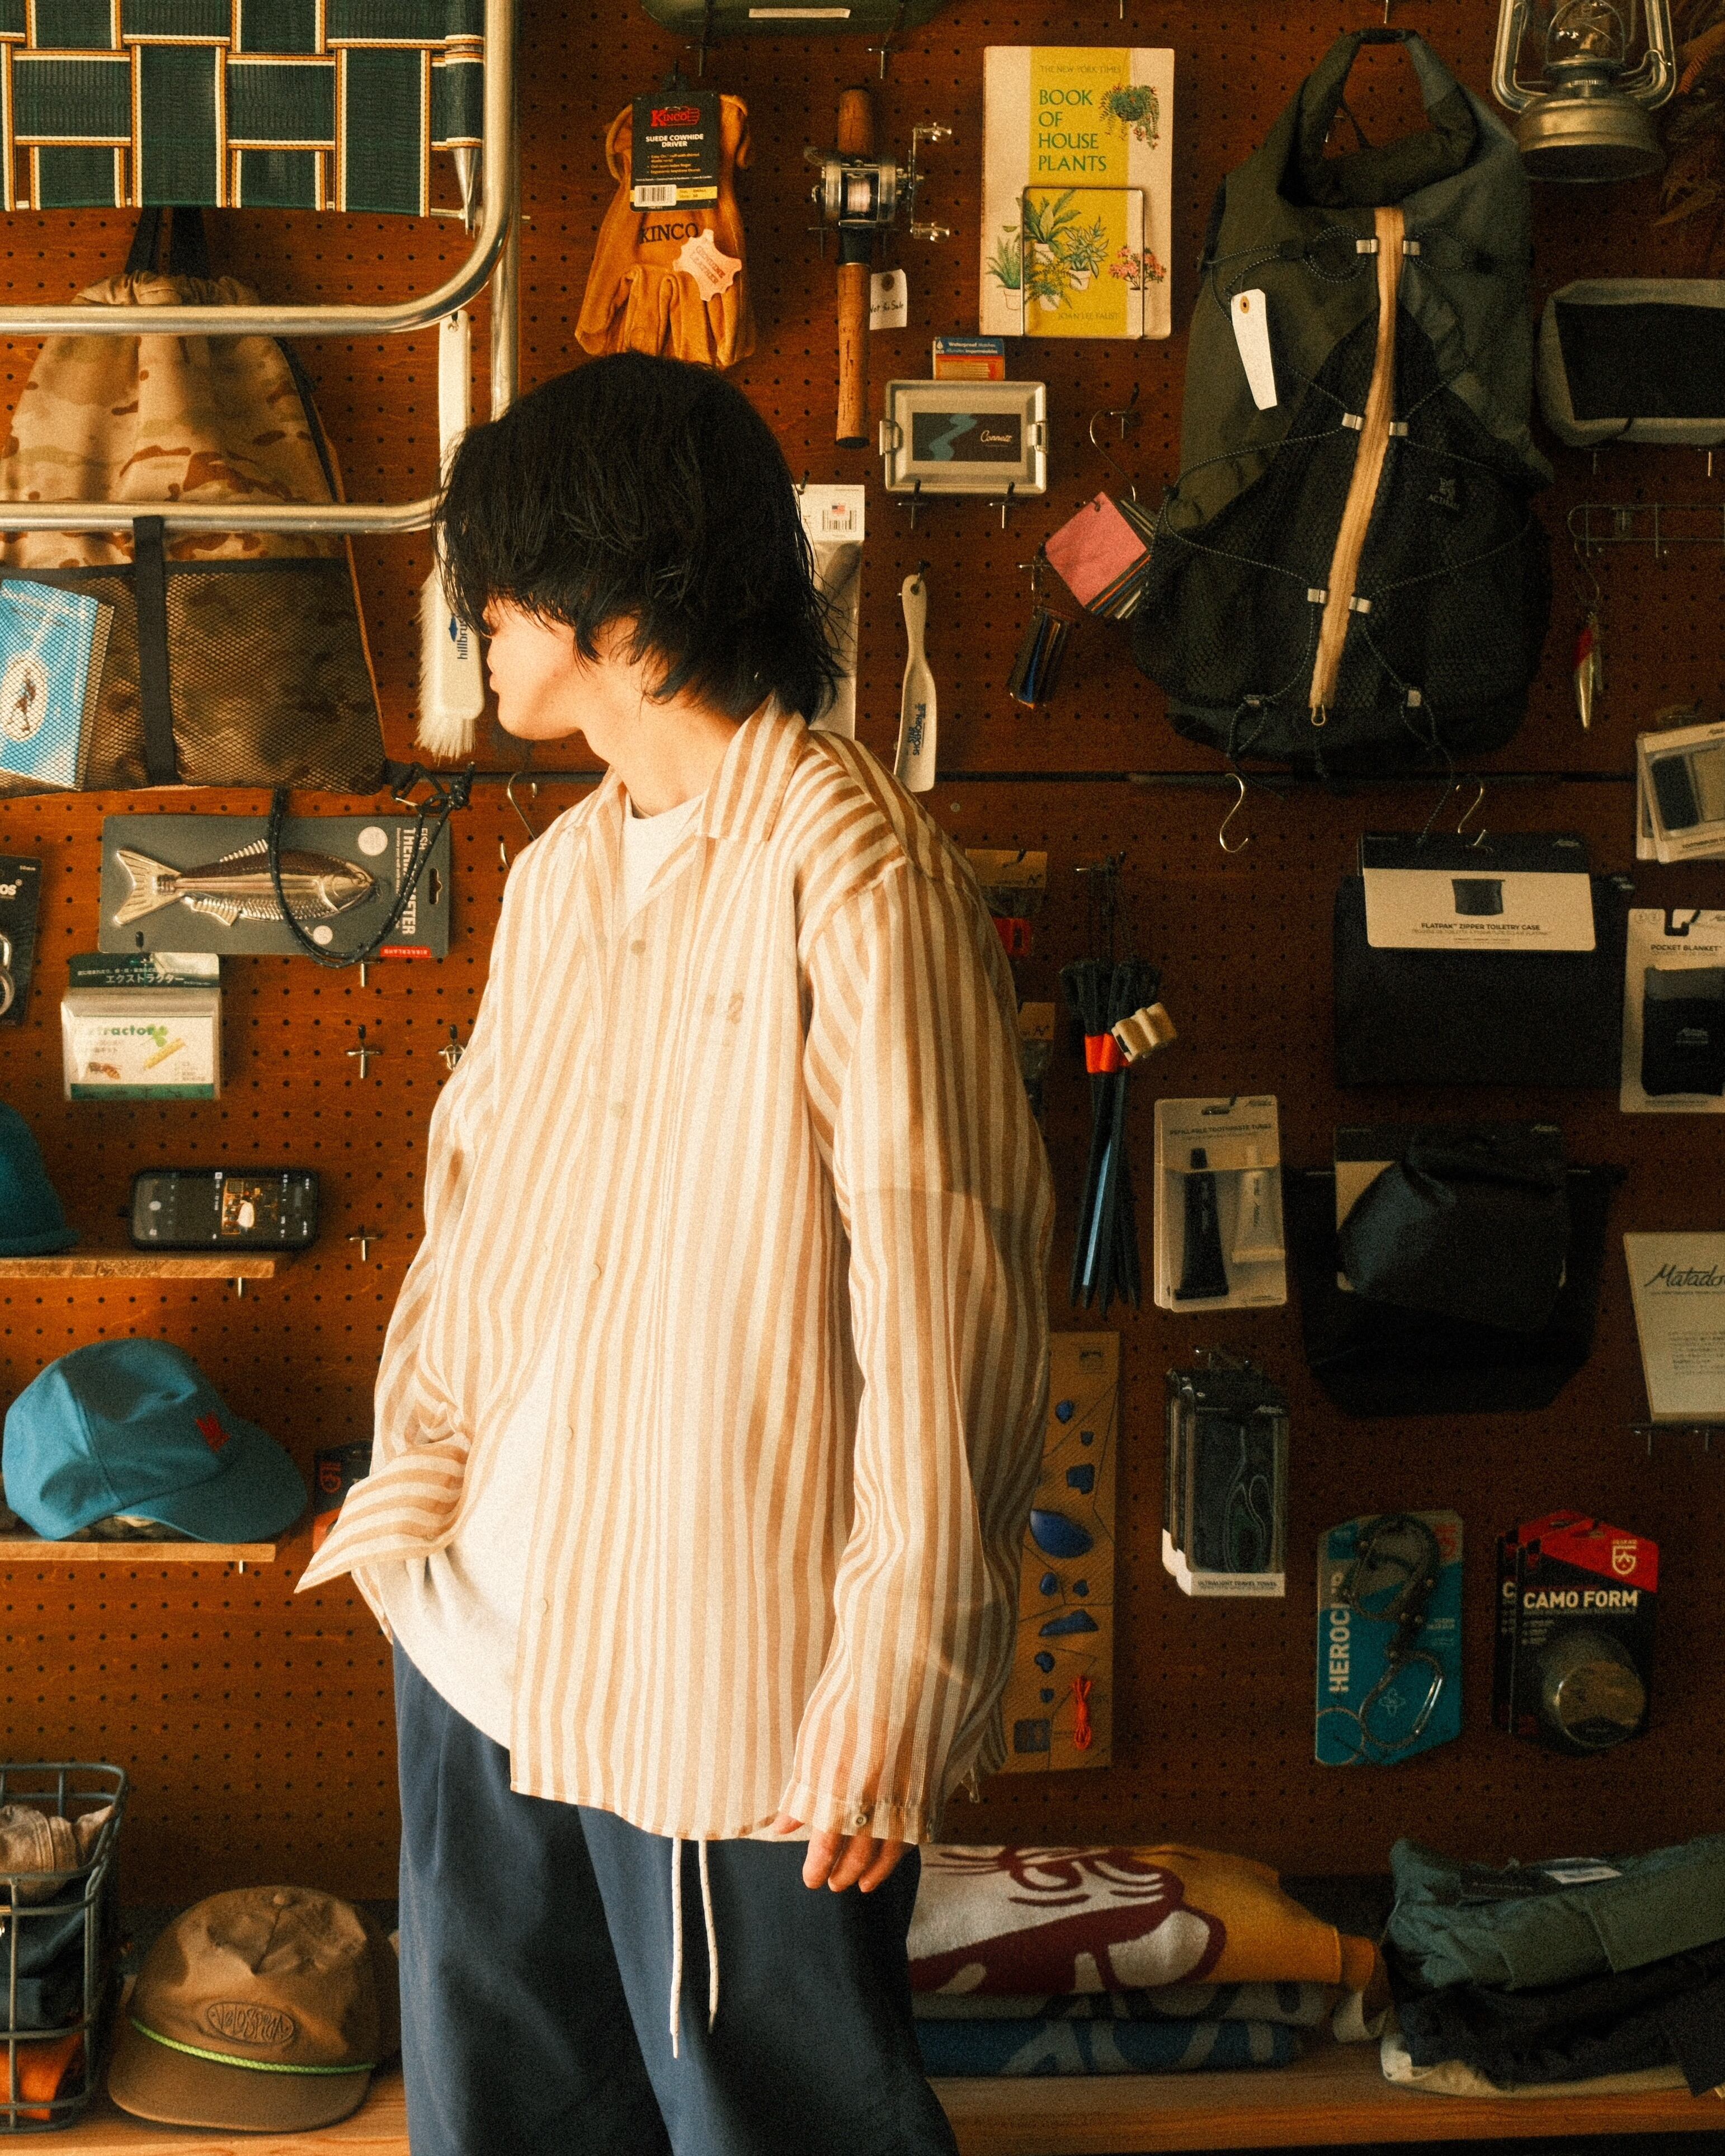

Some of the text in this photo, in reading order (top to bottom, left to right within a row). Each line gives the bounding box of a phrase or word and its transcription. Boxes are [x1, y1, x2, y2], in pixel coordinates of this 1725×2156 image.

[1039, 89, 1093, 105] BOOK
[651, 109, 689, 127] KINCO
[1039, 111, 1063, 127] OF
[1038, 133, 1099, 149] HOUSE
[1039, 155, 1107, 172] PLANTS
[639, 223, 699, 244] KINCO
[106, 974, 185, 984] エクストラクター
[1643, 1263, 1725, 1287] Matado
[1523, 1589, 1639, 1610] CAMO FORM
